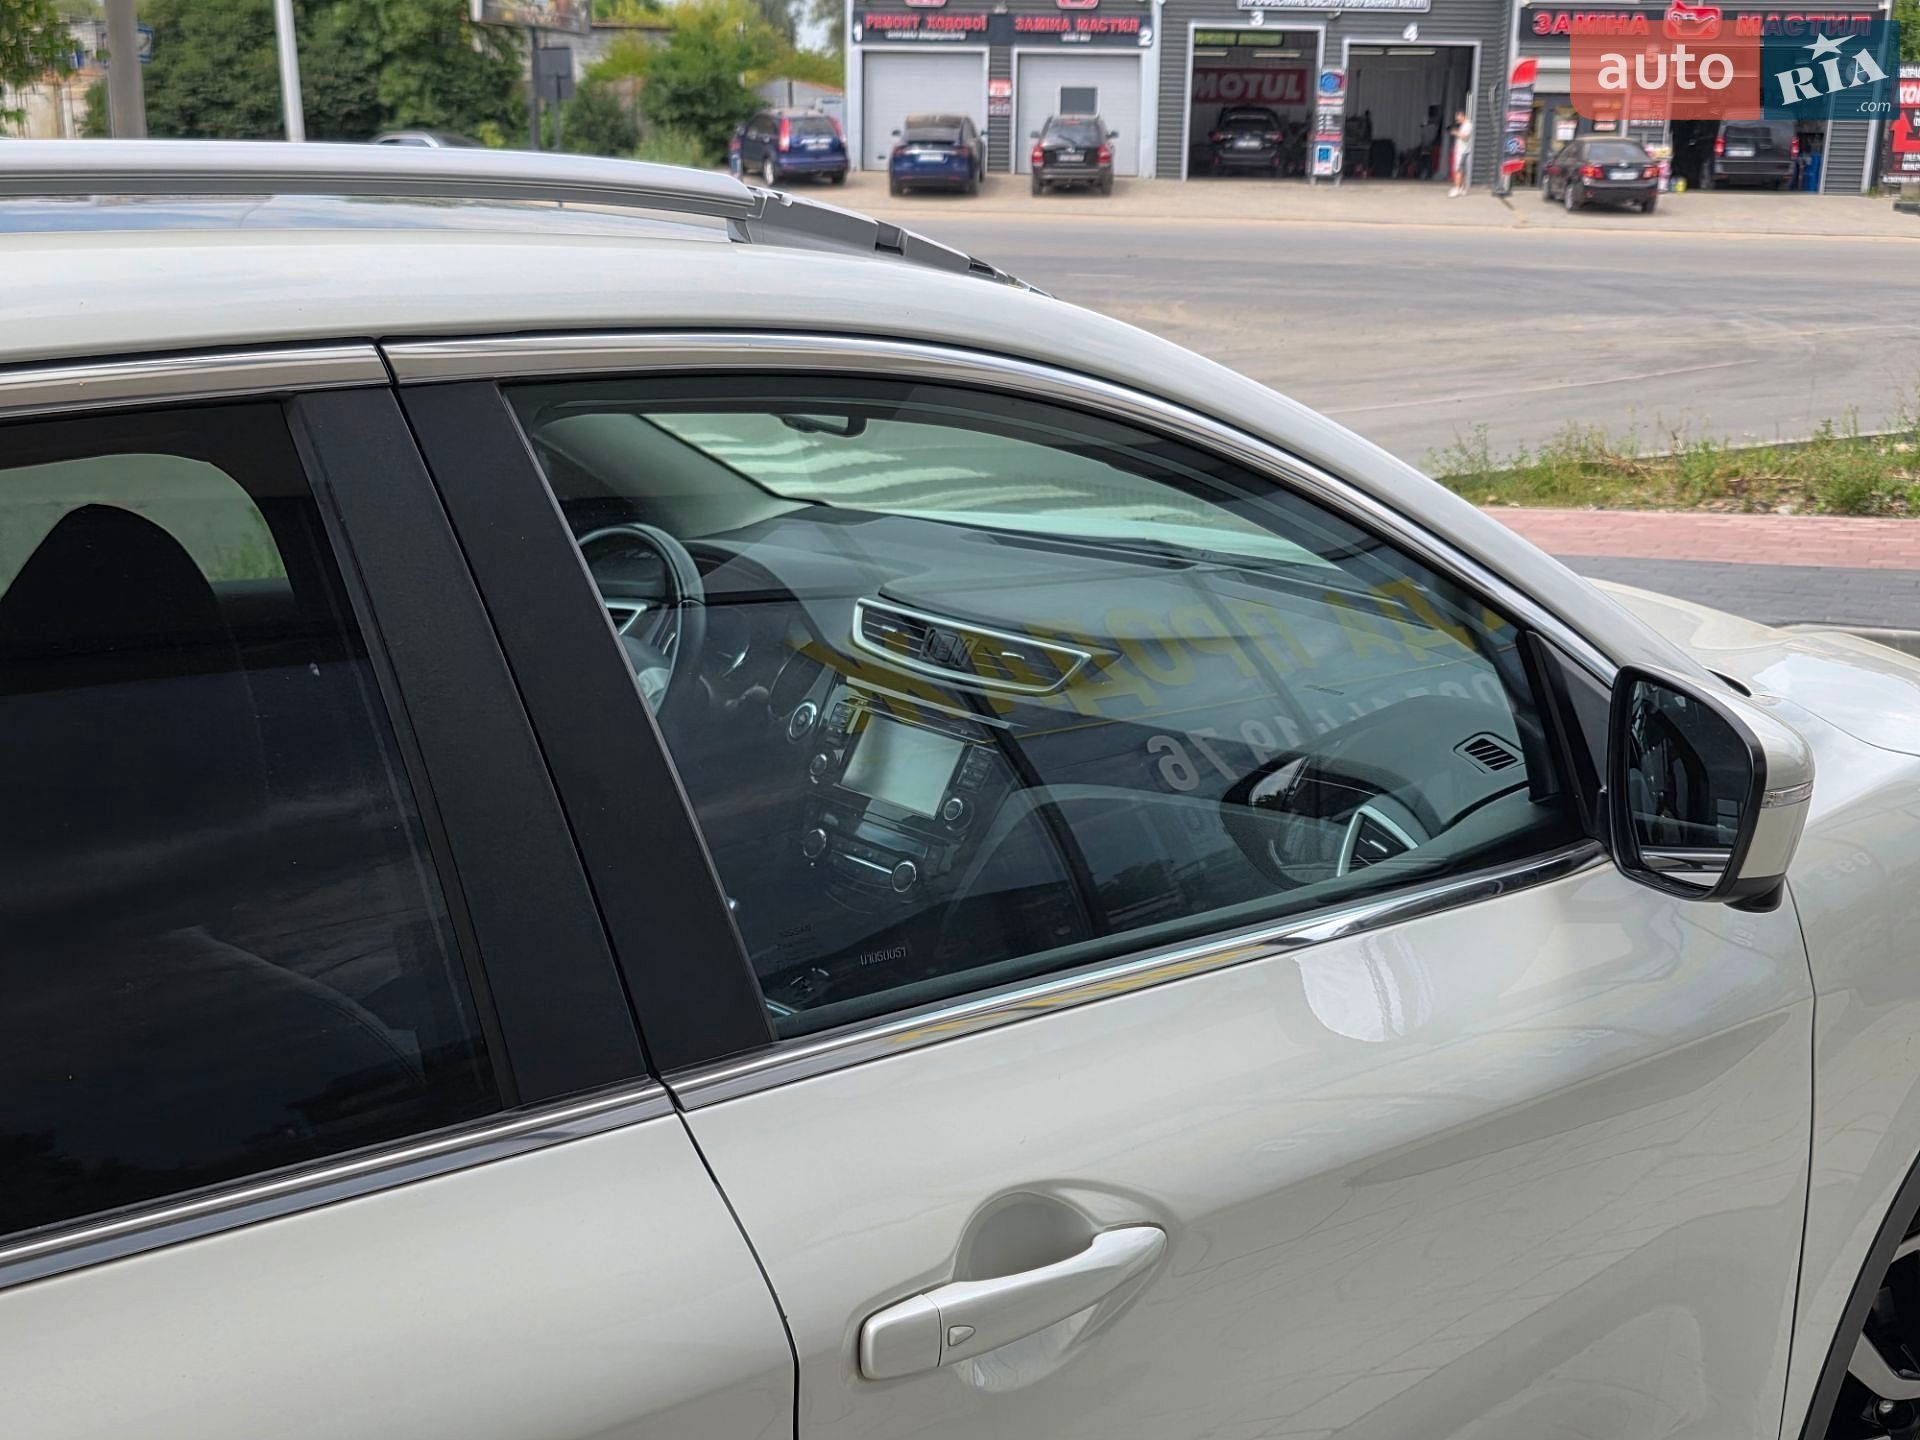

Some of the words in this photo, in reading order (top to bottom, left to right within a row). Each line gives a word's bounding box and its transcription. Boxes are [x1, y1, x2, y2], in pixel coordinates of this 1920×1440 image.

[1250, 11, 1265, 26] 3
[854, 22, 863, 42] 1
[1138, 27, 1153, 46] 2
[1402, 22, 1419, 41] 4
[1193, 72, 1302, 100] MOTUL
